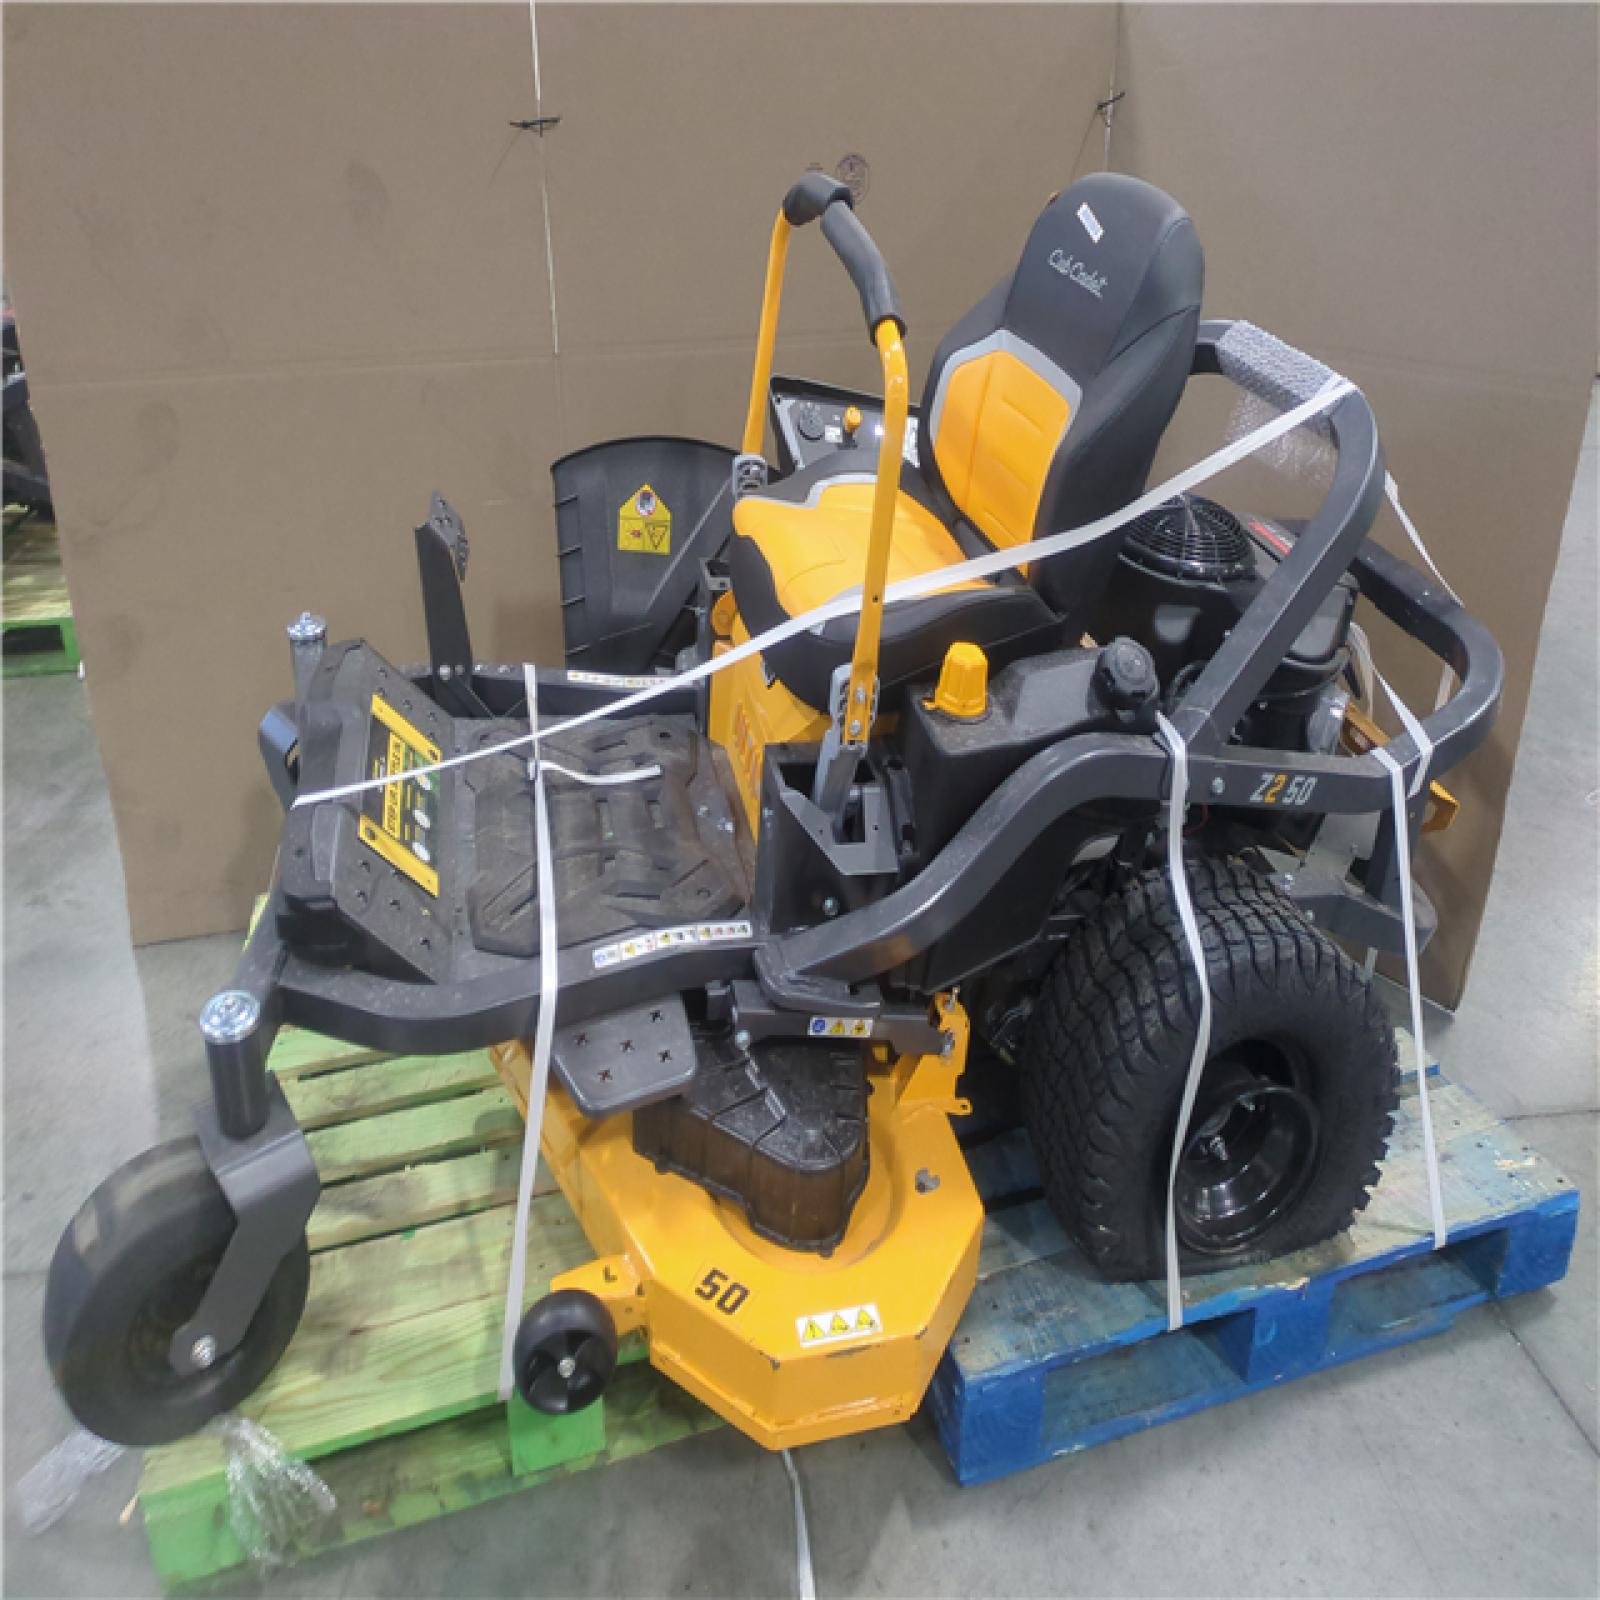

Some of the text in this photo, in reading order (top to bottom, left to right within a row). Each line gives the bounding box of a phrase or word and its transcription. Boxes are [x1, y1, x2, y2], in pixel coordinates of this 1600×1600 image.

[1048, 249, 1108, 299] Cub Cadet
[695, 1267, 750, 1316] 50
